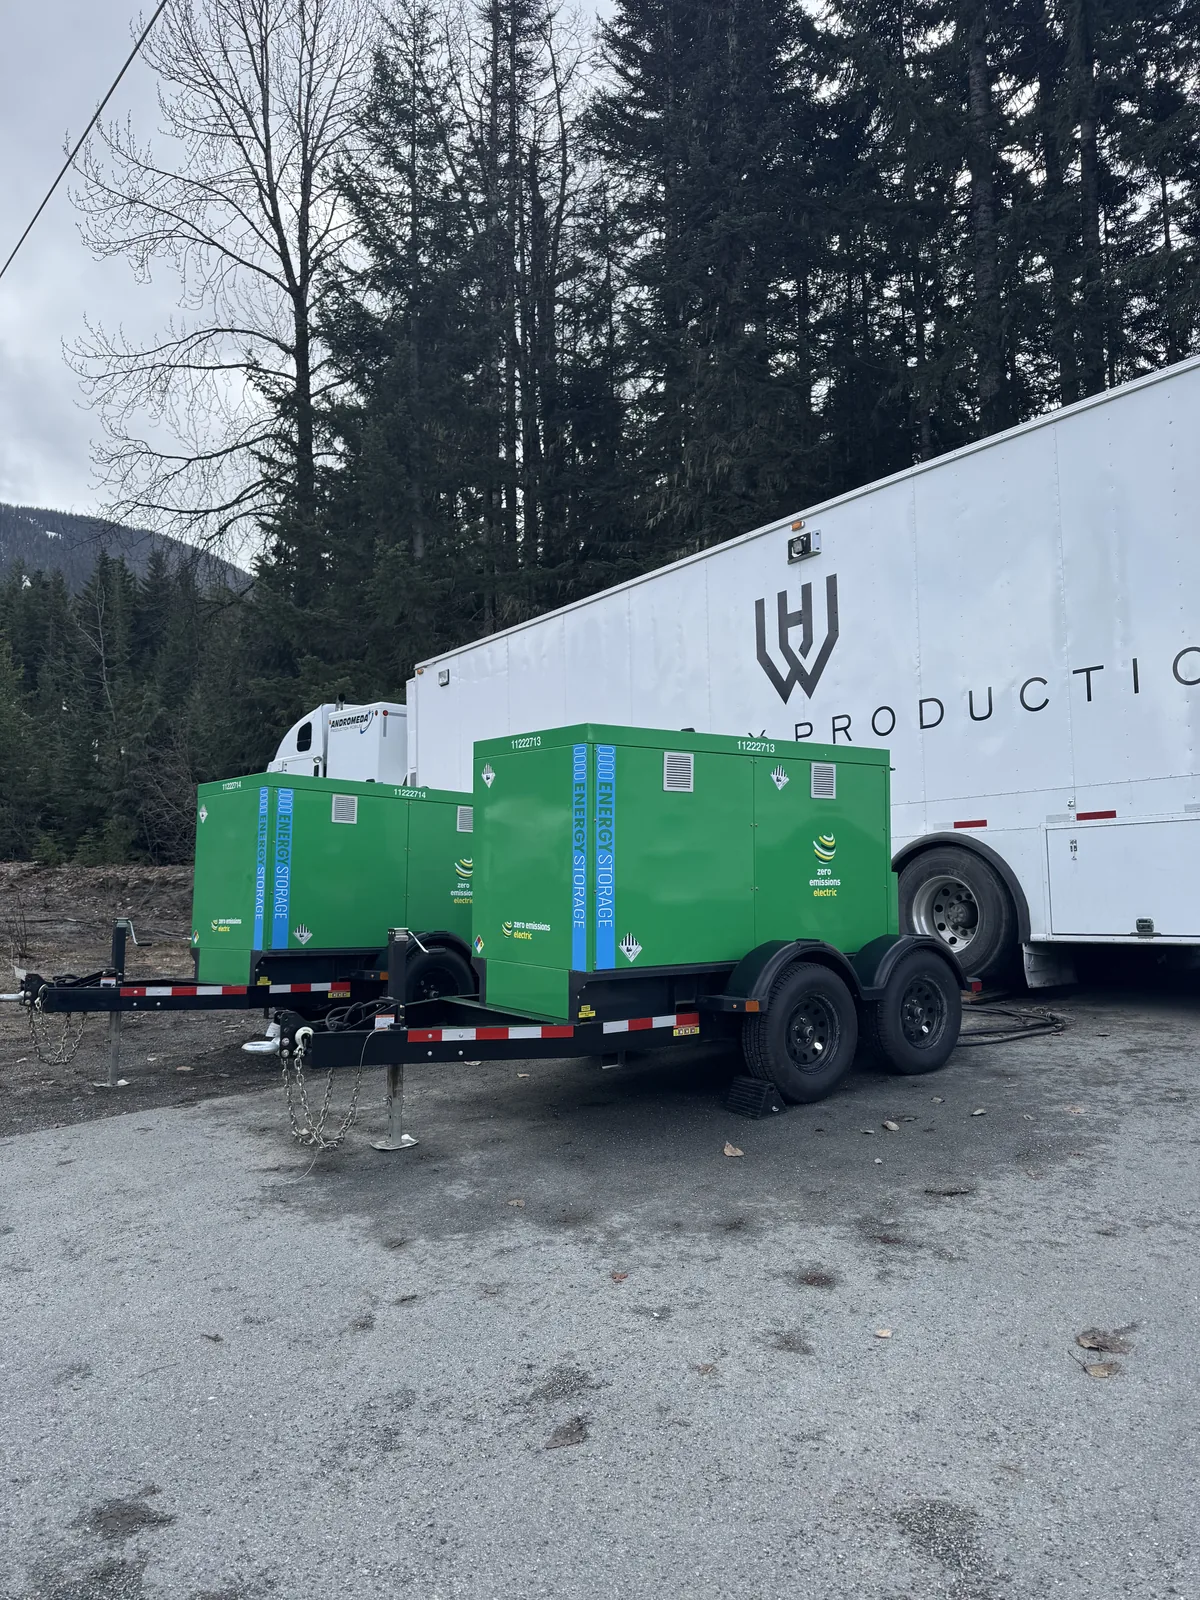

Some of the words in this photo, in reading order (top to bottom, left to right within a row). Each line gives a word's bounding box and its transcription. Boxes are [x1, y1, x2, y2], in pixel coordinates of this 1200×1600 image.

[331, 714, 369, 728] ANDROMEDA
[511, 736, 541, 750] 11222713
[736, 740, 776, 754] 11222713
[222, 781, 242, 791] 11222714
[393, 788, 426, 799] 11222714
[574, 782, 586, 855] ENERGY
[598, 781, 613, 853] ENERGY
[258, 814, 267, 866] ENERGY
[276, 814, 292, 866] ENERGY
[816, 868, 832, 876] zero
[809, 877, 841, 886] emissions
[255, 866, 265, 920] STORAGE
[273, 866, 290, 920] STORAGE
[573, 855, 586, 929] STORAGE
[597, 854, 613, 928] STORAGE
[813, 888, 838, 897] electric
[513, 921, 525, 929] zero
[525, 921, 551, 931] emissions
[513, 930, 532, 940] electric
